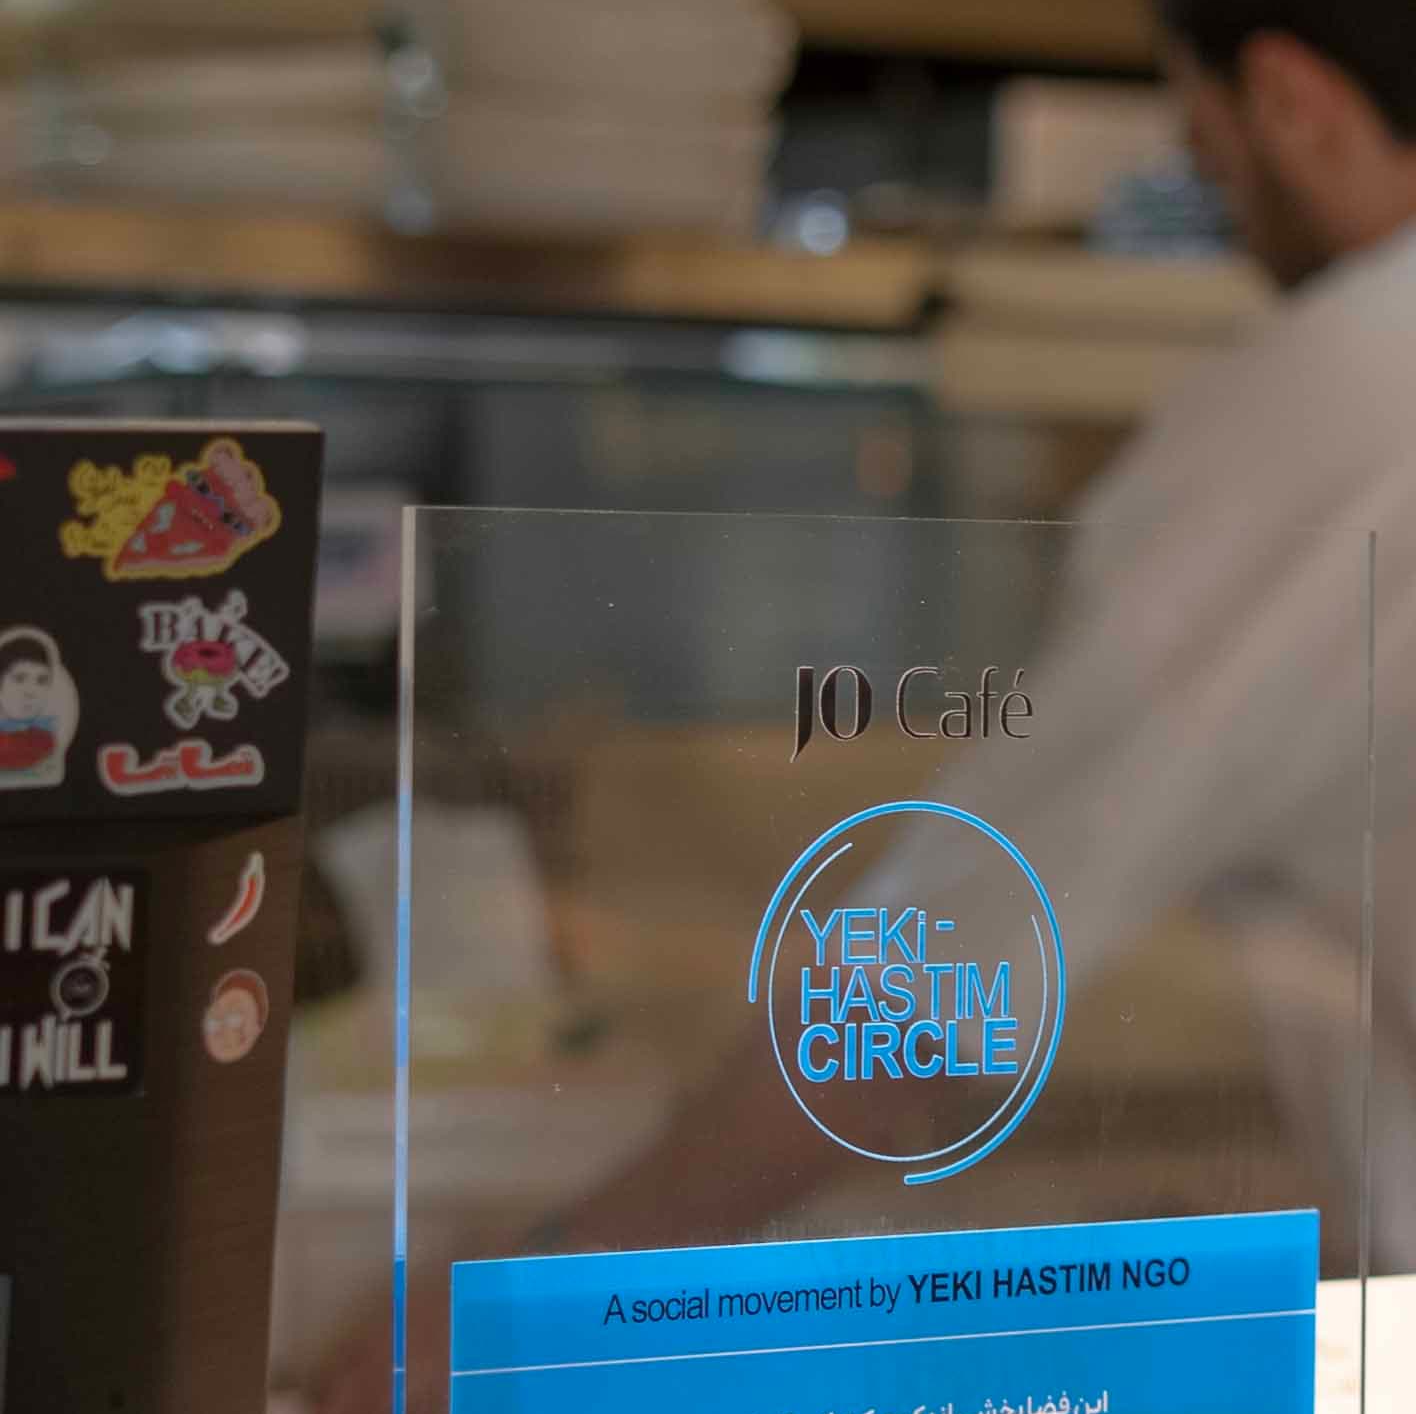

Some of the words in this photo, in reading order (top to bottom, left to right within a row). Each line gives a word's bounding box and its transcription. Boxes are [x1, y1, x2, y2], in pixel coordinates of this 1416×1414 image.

[789, 665, 873, 763] JO
[895, 665, 1033, 739] Café
[5, 890, 23, 951] I
[32, 877, 134, 956] CAN
[801, 961, 1010, 1025] HASTIM
[20, 1015, 128, 1090] WILL
[797, 1018, 1018, 1083] CIRCLE
[603, 1294, 627, 1325] A
[631, 1288, 709, 1324] social
[718, 1279, 861, 1317] movement
[870, 1277, 900, 1313] by
[908, 1270, 981, 1304] YEKI
[993, 1261, 1111, 1298] HASTIM
[1122, 1257, 1190, 1289] NGO
